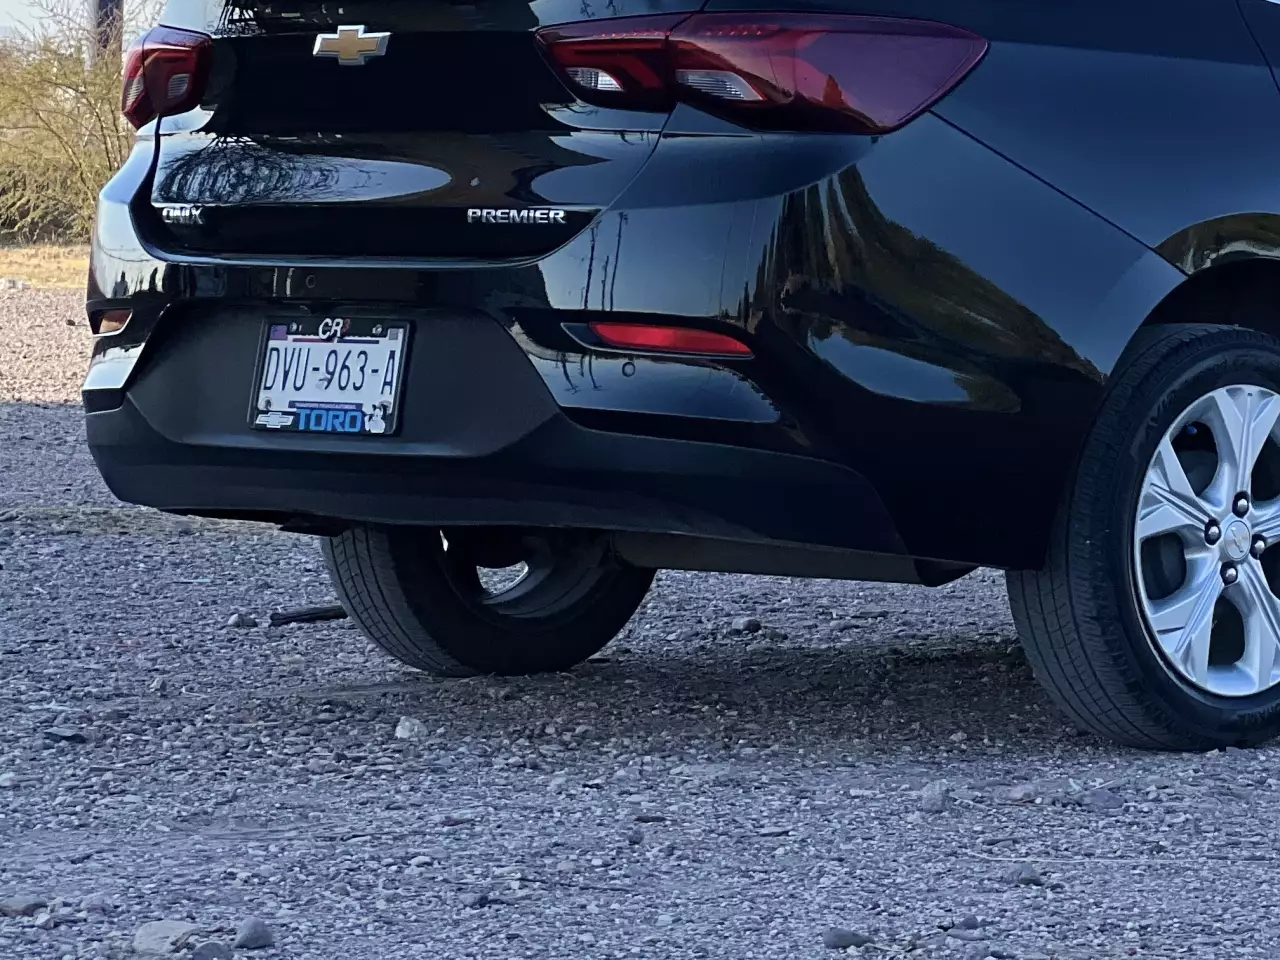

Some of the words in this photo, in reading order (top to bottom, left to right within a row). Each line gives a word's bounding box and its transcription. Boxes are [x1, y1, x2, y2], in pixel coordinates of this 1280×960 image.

[467, 208, 566, 224] PREMIER
[263, 347, 396, 395] DVU-963-A
[296, 408, 363, 433] TORO
